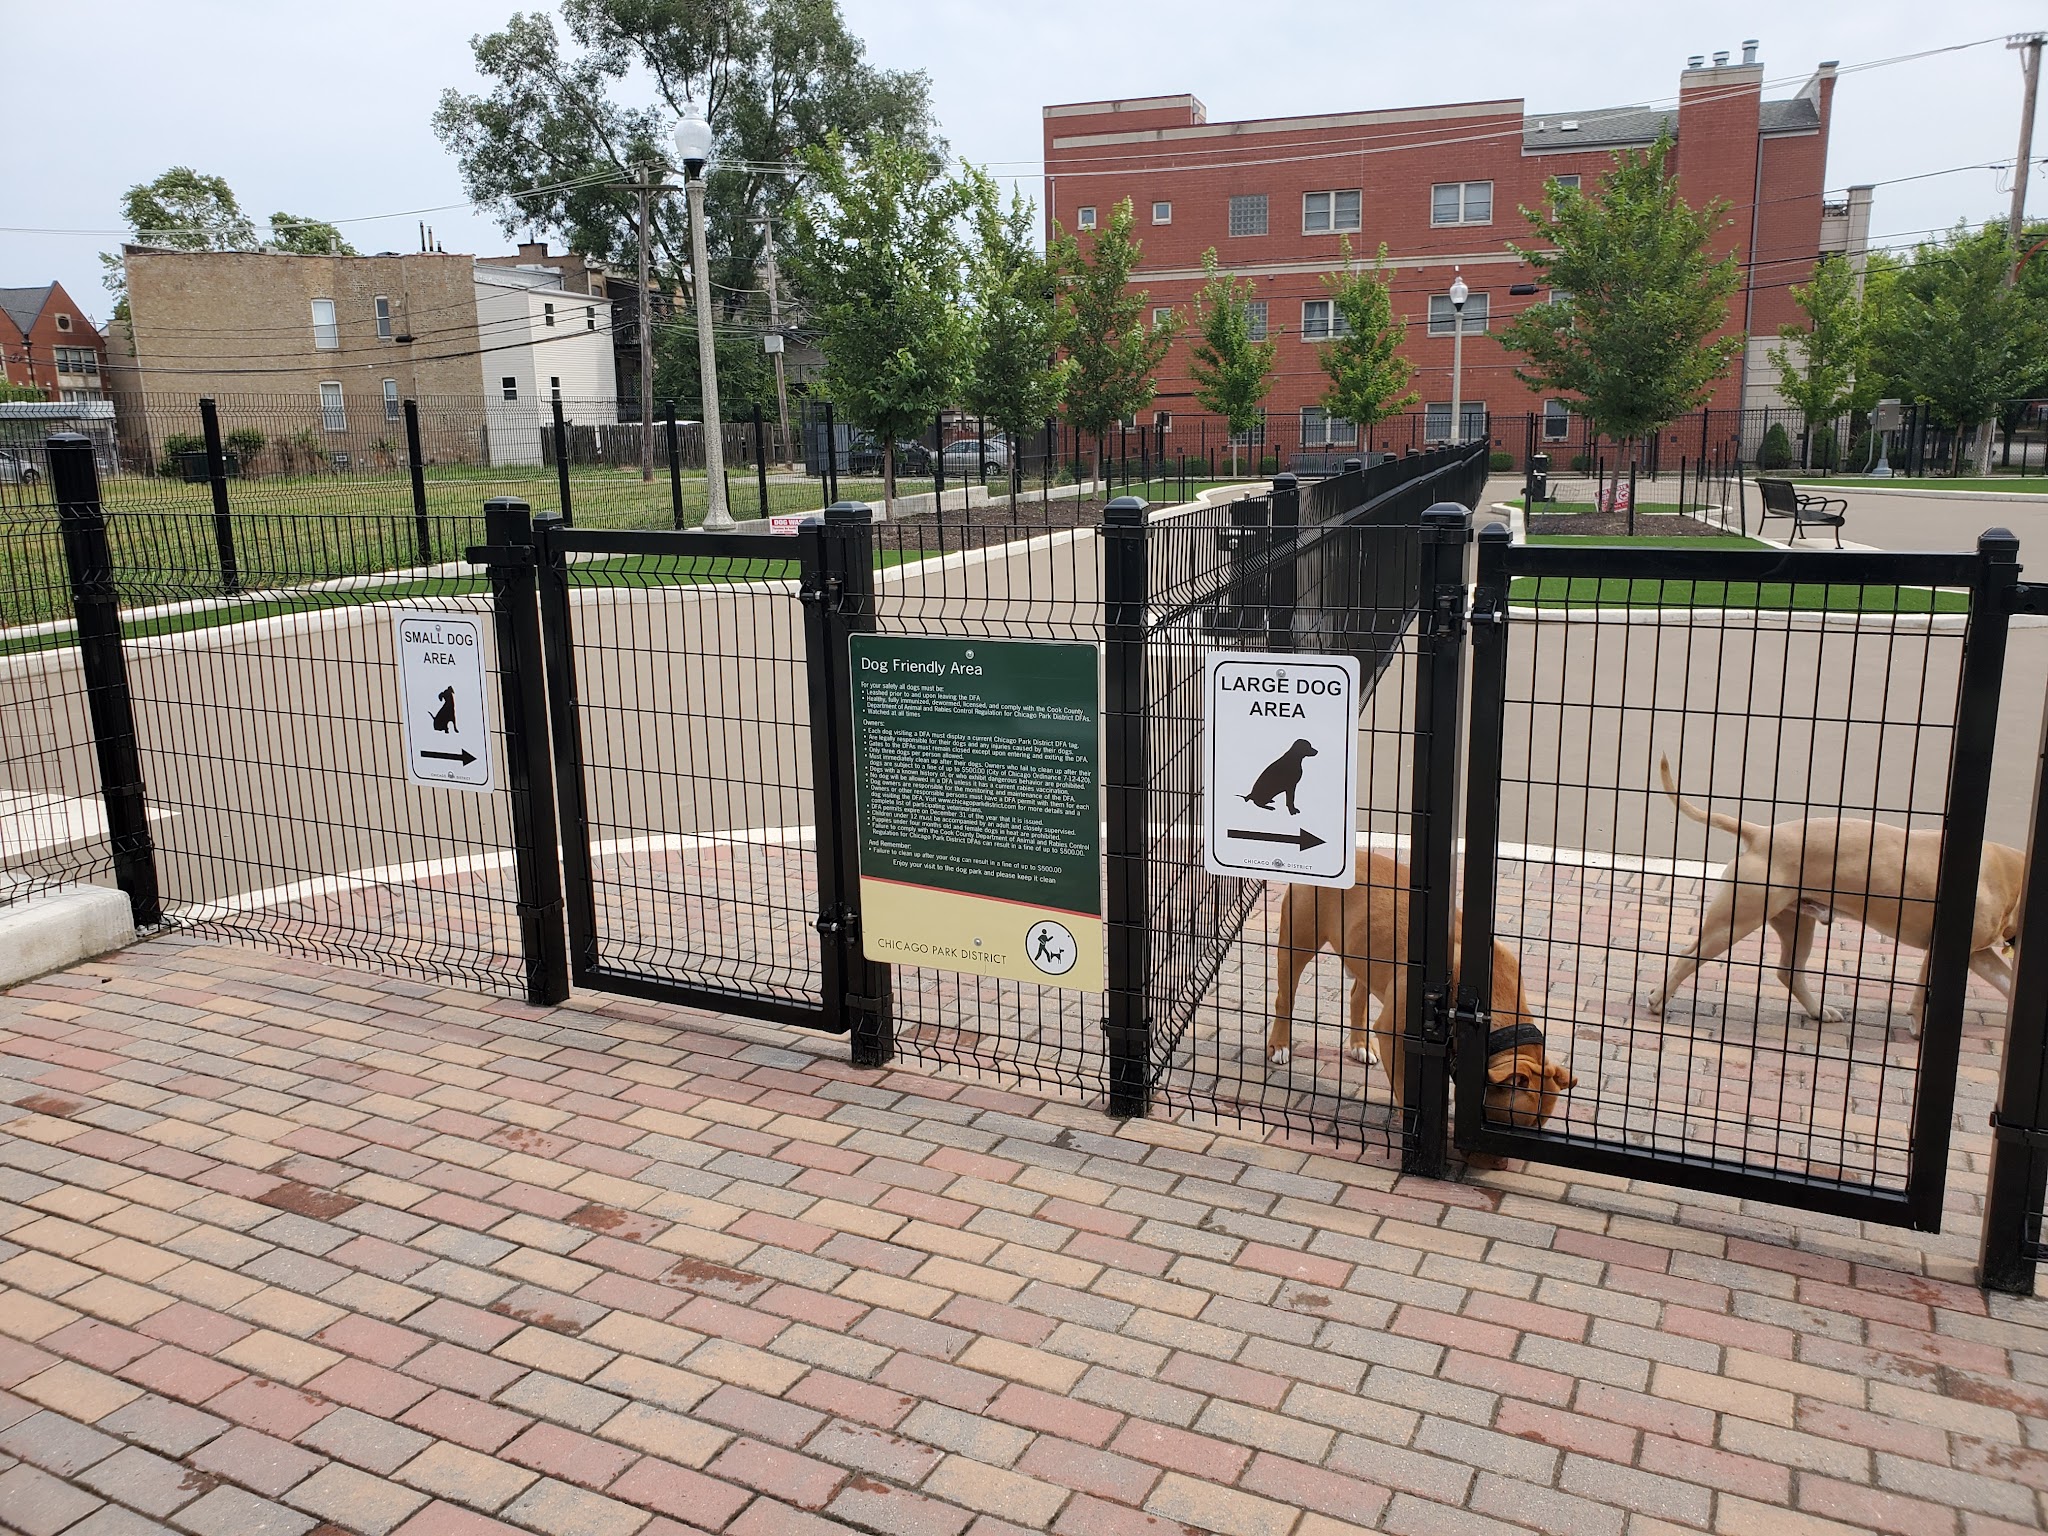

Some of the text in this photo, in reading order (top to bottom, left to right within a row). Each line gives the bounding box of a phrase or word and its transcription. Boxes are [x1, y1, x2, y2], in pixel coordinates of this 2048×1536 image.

[405, 631, 473, 646] SMALL DOG
[424, 652, 456, 665] AREA
[862, 657, 983, 676] Dog Friendly Area
[907, 684, 920, 692] dogs
[1221, 676, 1342, 695] LARGE DOG
[890, 690, 902, 698] prior
[938, 693, 957, 701] leaving
[867, 702, 897, 710] Department
[975, 709, 1002, 717] Regulation
[1014, 711, 1037, 719] Chicago
[1064, 707, 1083, 715] County
[1249, 702, 1305, 718] AREA
[897, 737, 927, 745] responsible
[953, 740, 966, 748] dogs
[991, 743, 1010, 751] injuries
[1058, 748, 1073, 756] dogs.
[947, 733, 966, 741] display
[994, 736, 1016, 745] Chicago
[972, 748, 990, 756] except
[1007, 751, 1030, 759] entering
[1045, 753, 1063, 762] exiting
[942, 817, 978, 827] accompanied
[1023, 825, 1042, 833] closely
[1045, 827, 1076, 836] supervised.
[880, 840, 911, 849] Remember:
[893, 859, 908, 868] Enjoy
[956, 866, 967, 874] dog
[969, 868, 982, 876] park
[996, 871, 1016, 880] please
[1017, 873, 1032, 882] keep
[950, 855, 960, 863] dog
[1038, 865, 1062, 873] $500.00
[878, 939, 1007, 965] CHICAGO PARK DISTRICT
